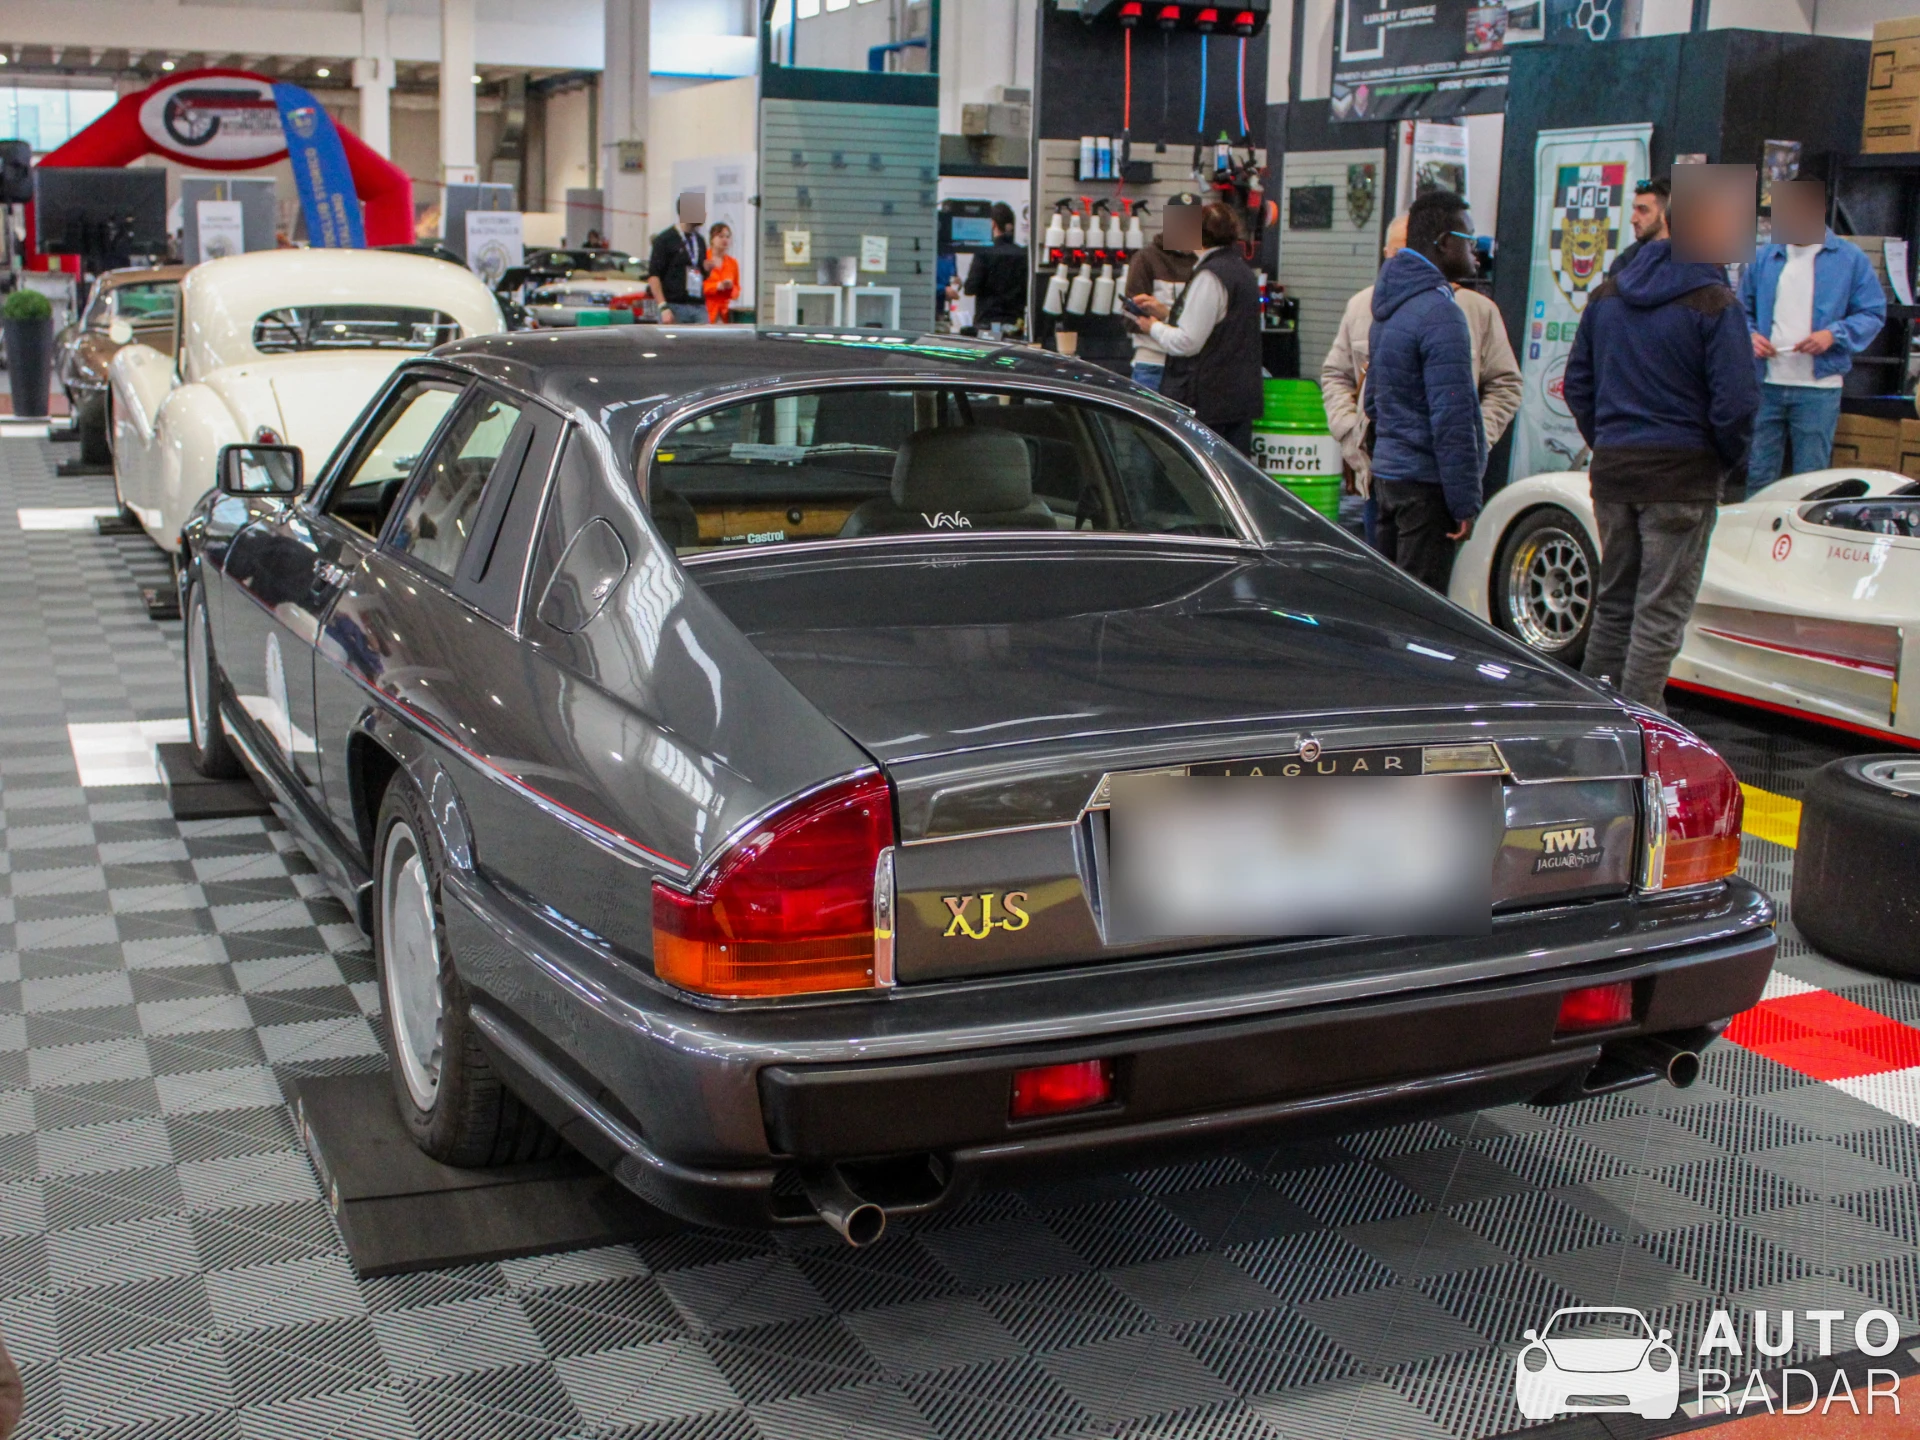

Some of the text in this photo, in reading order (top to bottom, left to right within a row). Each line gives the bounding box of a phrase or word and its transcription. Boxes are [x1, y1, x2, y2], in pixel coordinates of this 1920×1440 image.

[1568, 186, 1610, 207] JAG
[1252, 437, 1318, 456] General
[747, 530, 784, 544] Castrol
[1543, 827, 1597, 854] TWR
